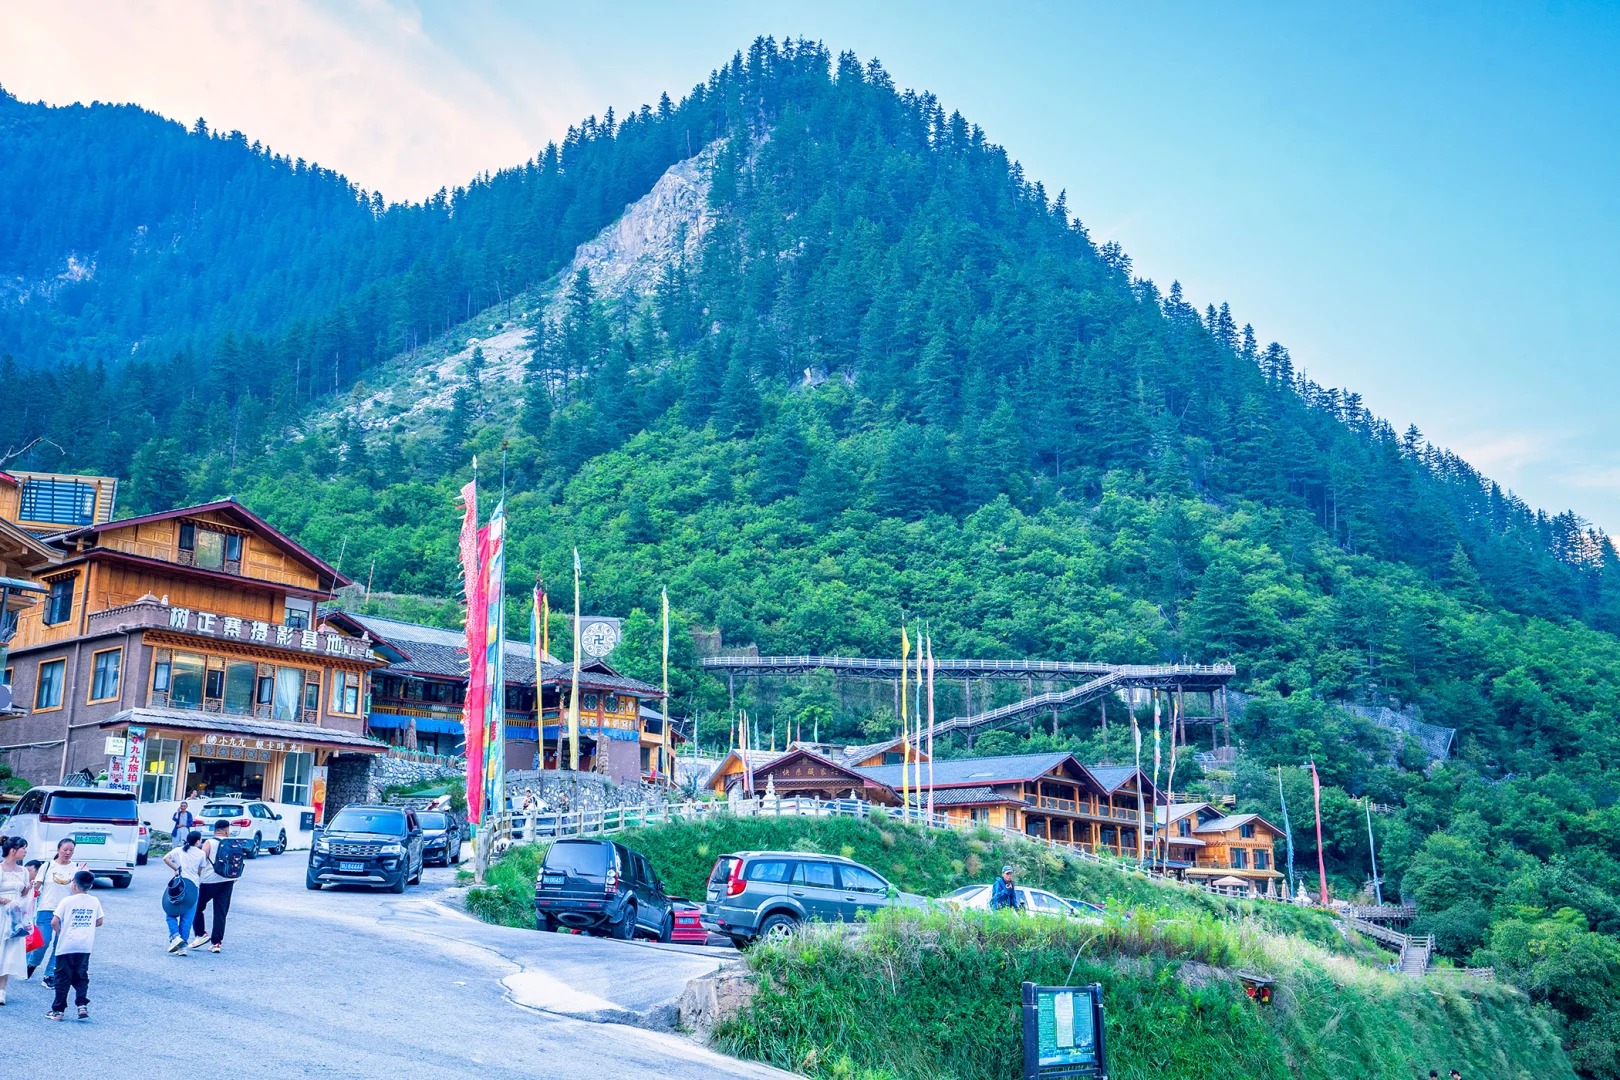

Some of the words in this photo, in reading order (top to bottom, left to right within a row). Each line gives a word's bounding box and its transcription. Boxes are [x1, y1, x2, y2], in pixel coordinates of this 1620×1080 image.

[169, 607, 342, 654] 树正寨摄影基地
[127, 735, 141, 782] 小九九旅拍
[219, 736, 246, 747] 小九九
